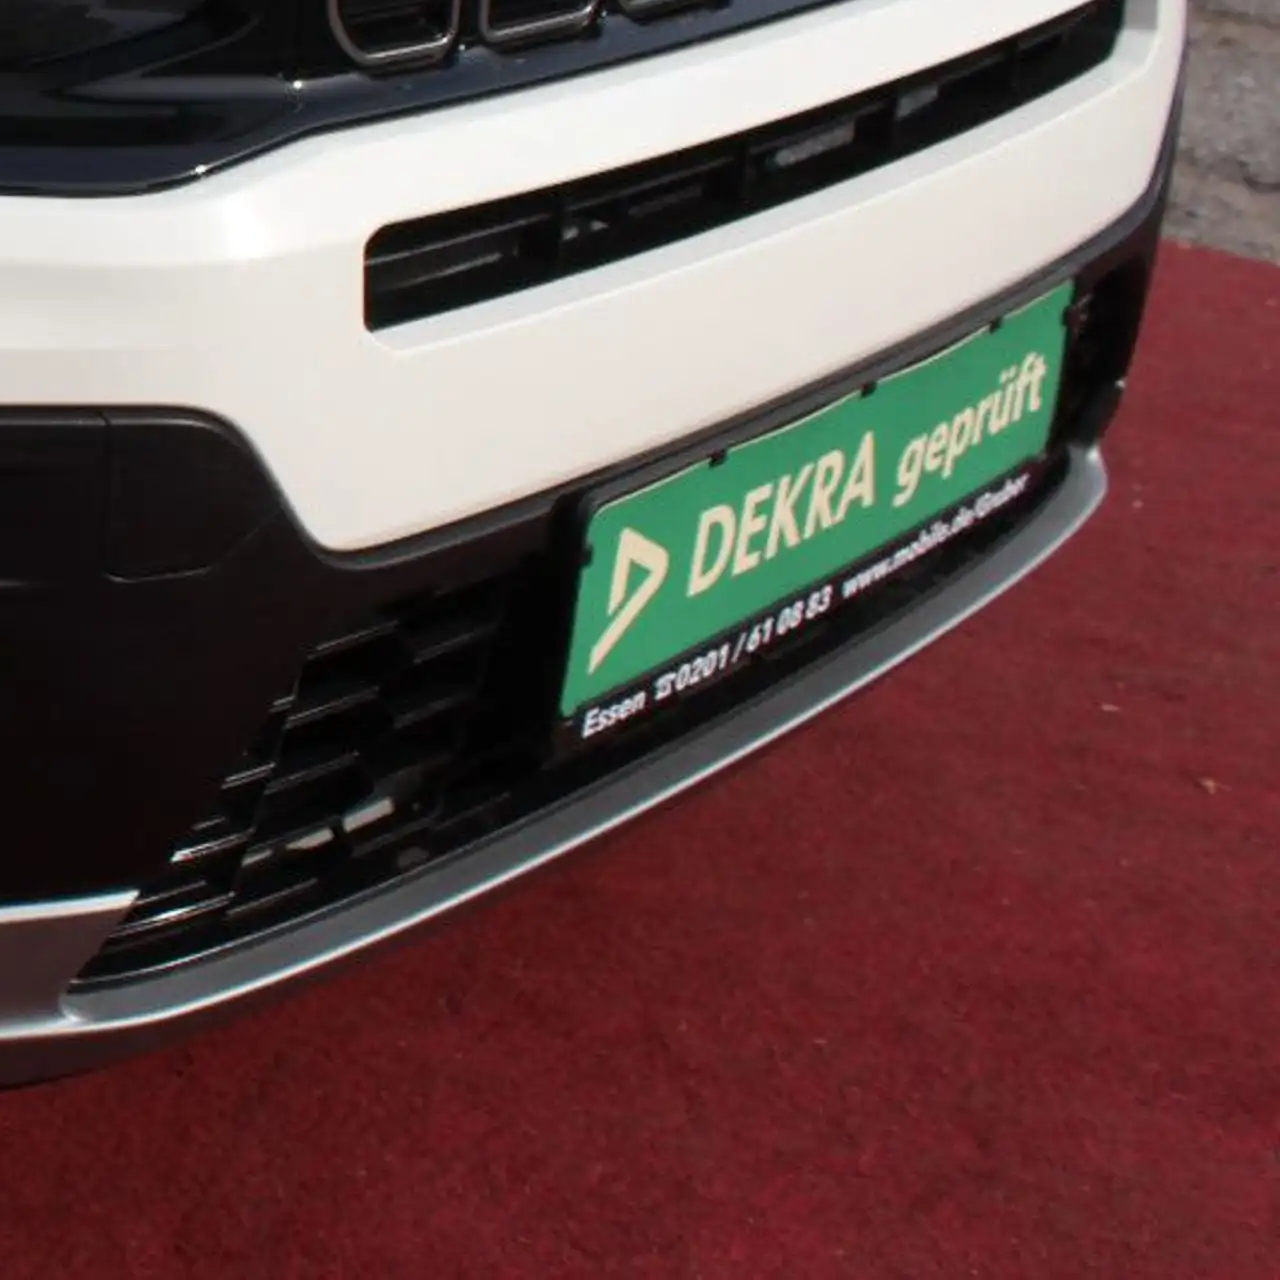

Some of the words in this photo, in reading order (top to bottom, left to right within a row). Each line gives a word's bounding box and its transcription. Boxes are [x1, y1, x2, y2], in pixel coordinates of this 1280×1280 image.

[687, 430, 875, 598] DEKRA
[893, 351, 1046, 508] geprüft
[582, 690, 647, 739] Essen
